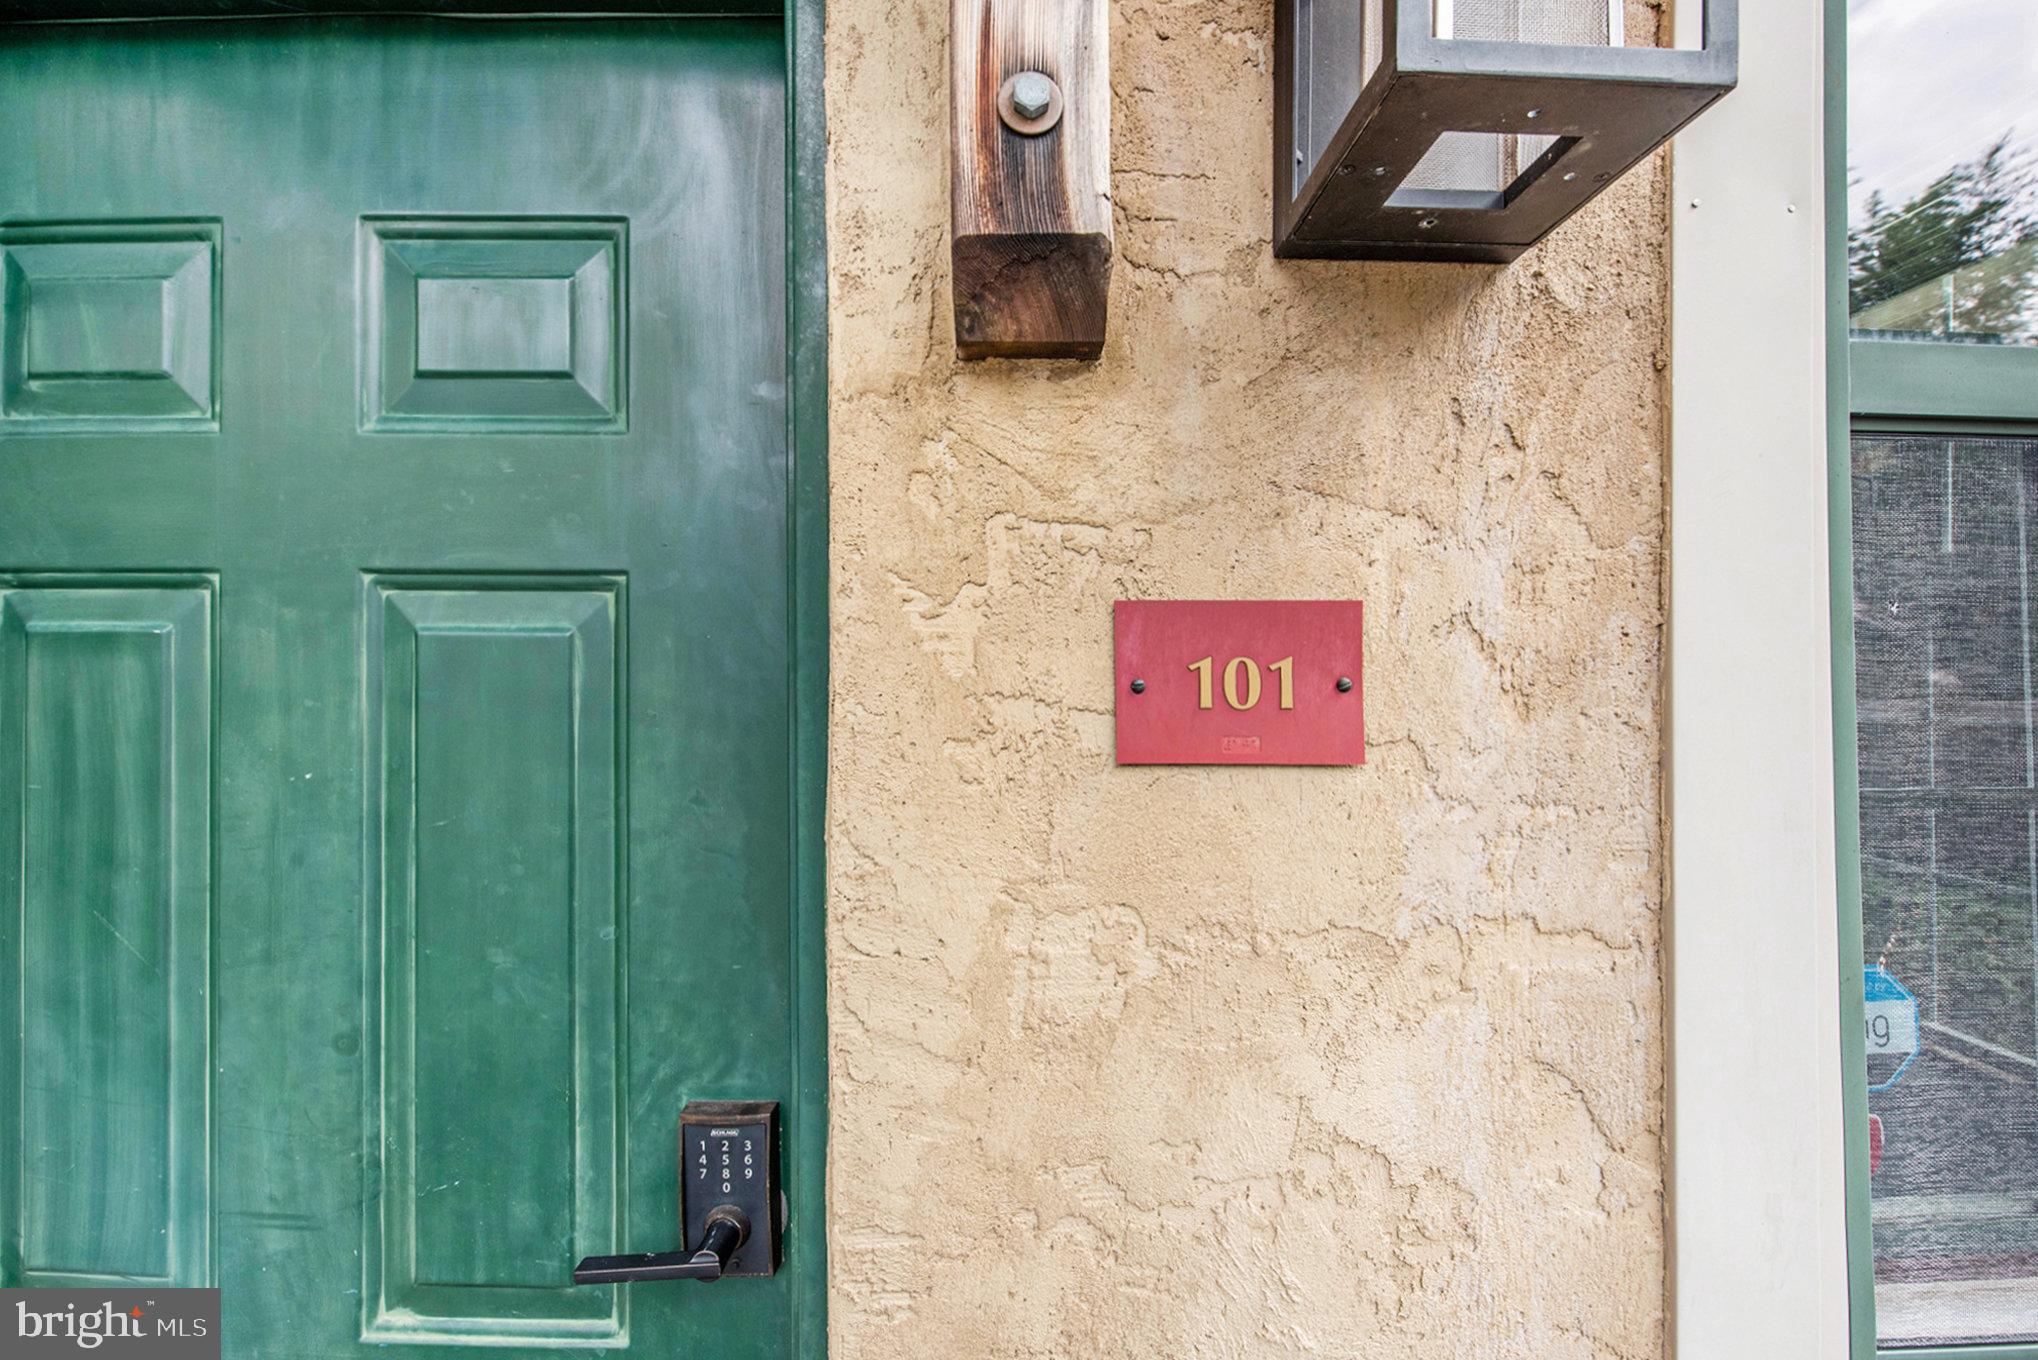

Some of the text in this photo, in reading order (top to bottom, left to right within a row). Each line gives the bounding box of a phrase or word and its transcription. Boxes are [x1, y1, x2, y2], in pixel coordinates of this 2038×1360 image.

[1187, 656, 1294, 711] 101
[700, 1140, 752, 1152] 1 2 3
[699, 1154, 752, 1166] 4 5 6
[699, 1168, 753, 1180] 7 8 9
[722, 1182, 731, 1194] 0
